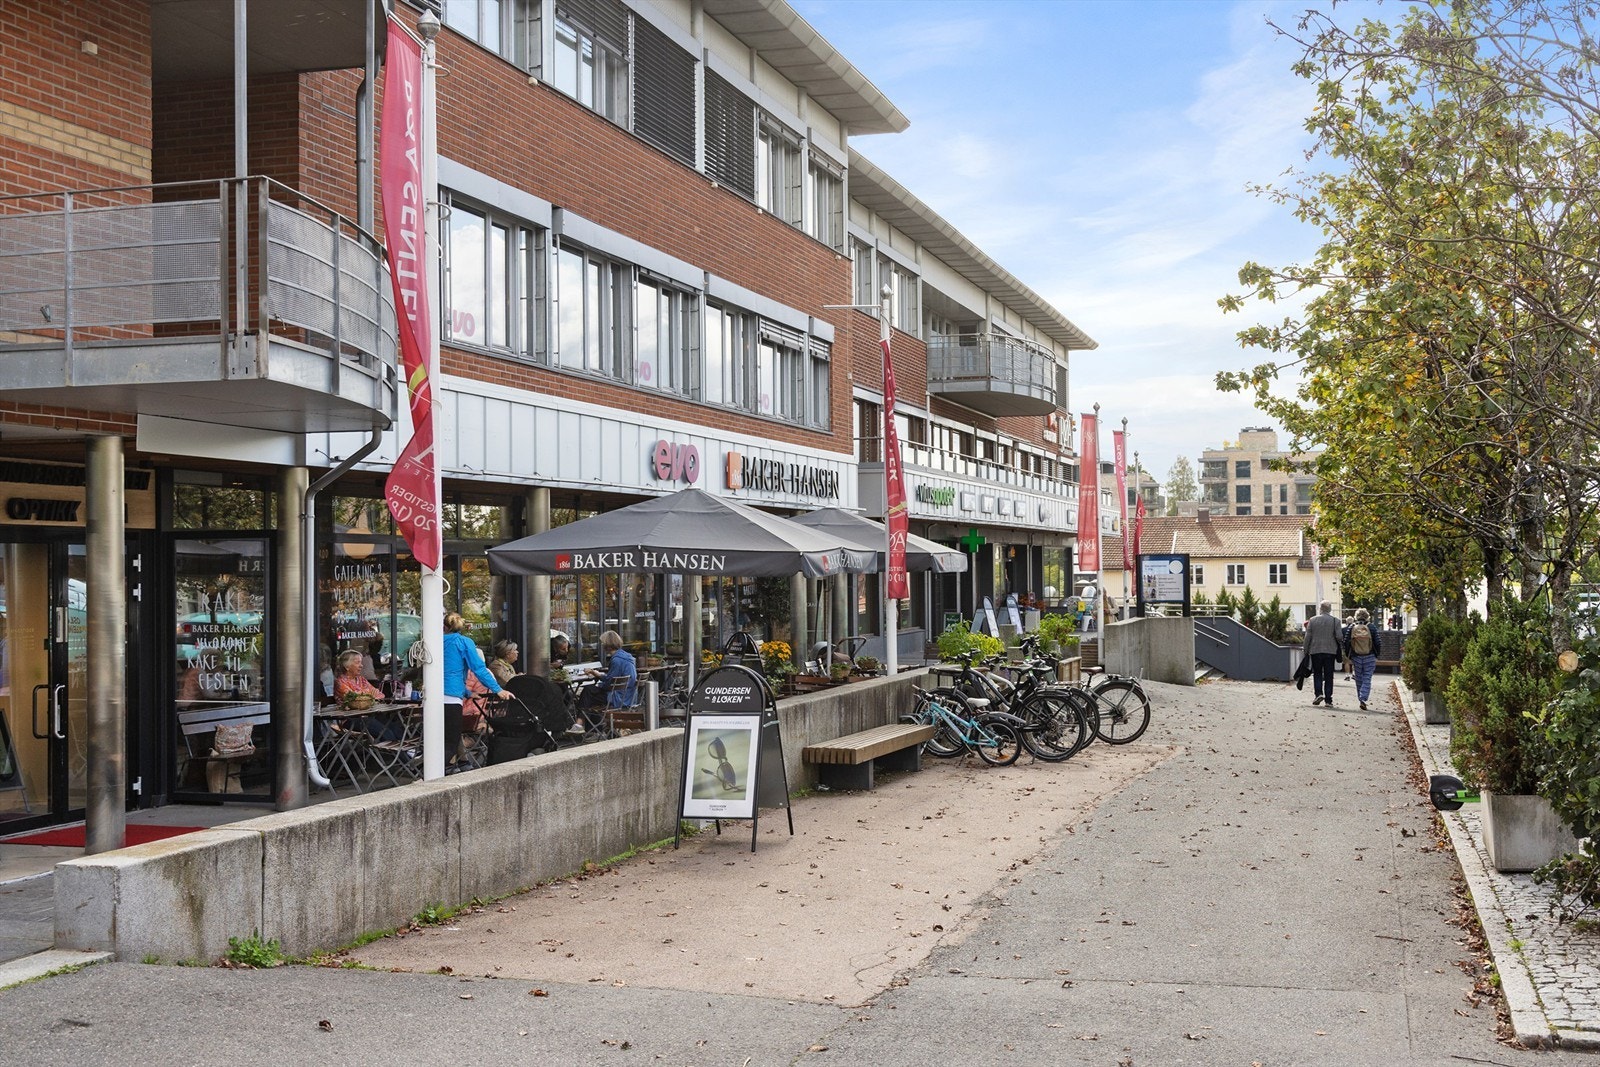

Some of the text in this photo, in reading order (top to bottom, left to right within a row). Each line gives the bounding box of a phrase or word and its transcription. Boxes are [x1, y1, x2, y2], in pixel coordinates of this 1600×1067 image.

[652, 439, 700, 483] evo
[741, 455, 785, 492] BAKER
[790, 463, 839, 499] HANSEN
[6, 497, 81, 521] OPTIKK
[559, 552, 727, 571] 1861 BAKER HANSEN
[192, 624, 260, 633] BAKER HANSEN
[342, 630, 376, 639] BAKER HANSEN
[187, 654, 217, 670] KAKE
[198, 673, 248, 691] FESTEN
[705, 686, 752, 695] GUNDERSEN
[717, 695, 743, 703] LØKEN
